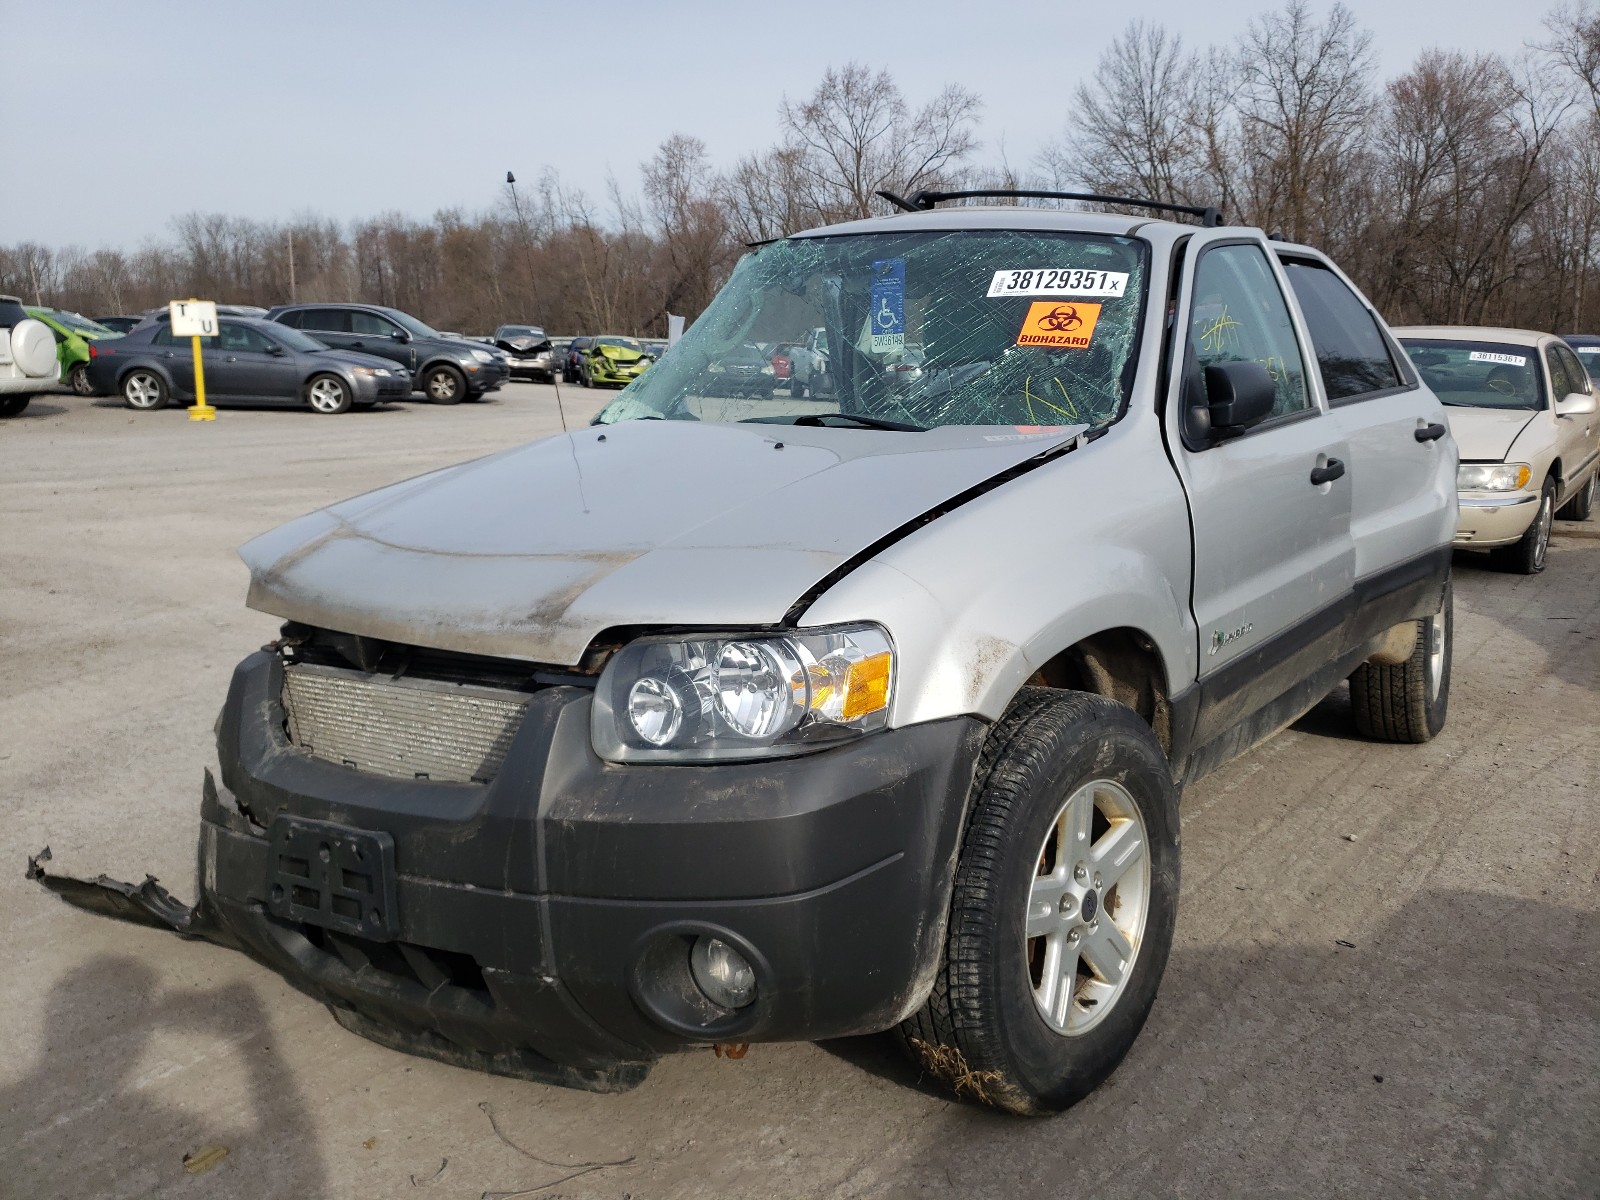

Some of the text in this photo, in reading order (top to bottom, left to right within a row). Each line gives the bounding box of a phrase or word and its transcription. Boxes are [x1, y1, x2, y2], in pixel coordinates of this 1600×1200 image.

[177, 303, 188, 316] T
[202, 320, 213, 333] U
[1019, 334, 1089, 346] BIOHAZARD
